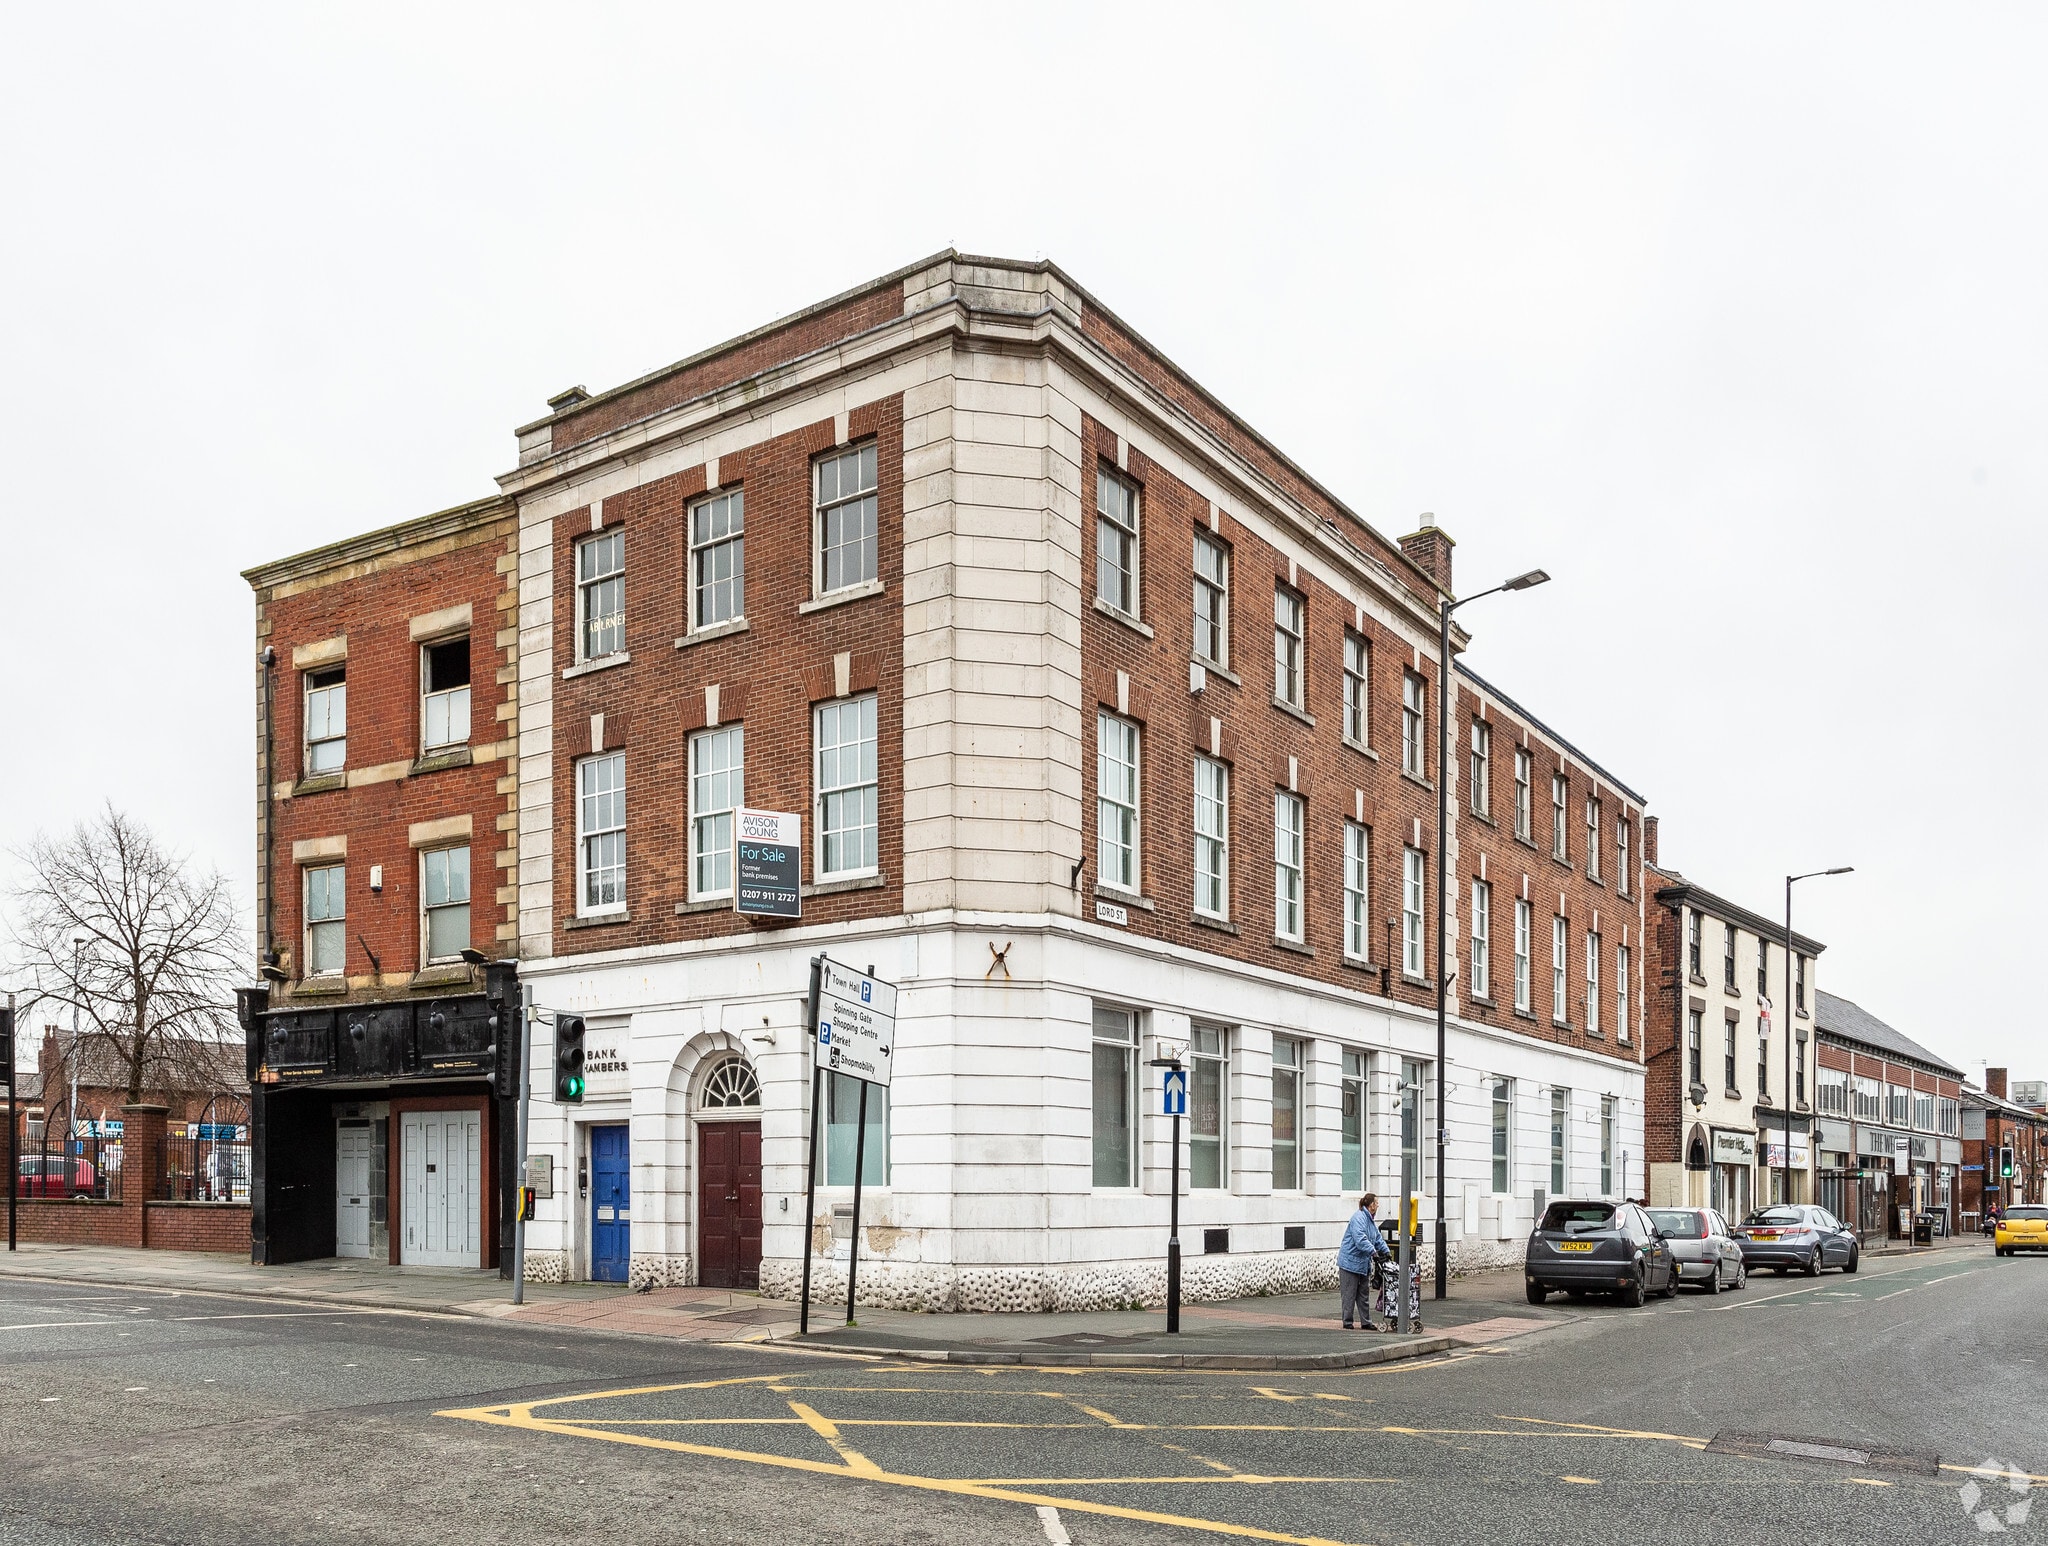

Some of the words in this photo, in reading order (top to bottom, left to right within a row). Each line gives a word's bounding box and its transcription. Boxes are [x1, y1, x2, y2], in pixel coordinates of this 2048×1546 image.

[743, 816, 778, 828] AVISON
[743, 826, 778, 838] YOUNG
[741, 845, 759, 860] For
[762, 847, 785, 862] Sale
[742, 863, 760, 871] Former
[742, 889, 760, 899] 0207
[763, 891, 775, 900] 911
[777, 893, 796, 902] 2727
[1098, 905, 1115, 918] LORD
[832, 973, 847, 989] Town
[849, 982, 860, 994] Hall
[833, 1002, 858, 1020] Spinning
[860, 1011, 872, 1024] Gate
[833, 1016, 859, 1035] Shopping
[860, 1026, 878, 1040] Centre
[831, 1033, 851, 1048] Market
[587, 1049, 616, 1060] BANK
[585, 1061, 628, 1073] HAMBERS.
[841, 1054, 876, 1075] Shopmobility
[1718, 1135, 1735, 1149] Premier
[1870, 1131, 1884, 1153] THE
